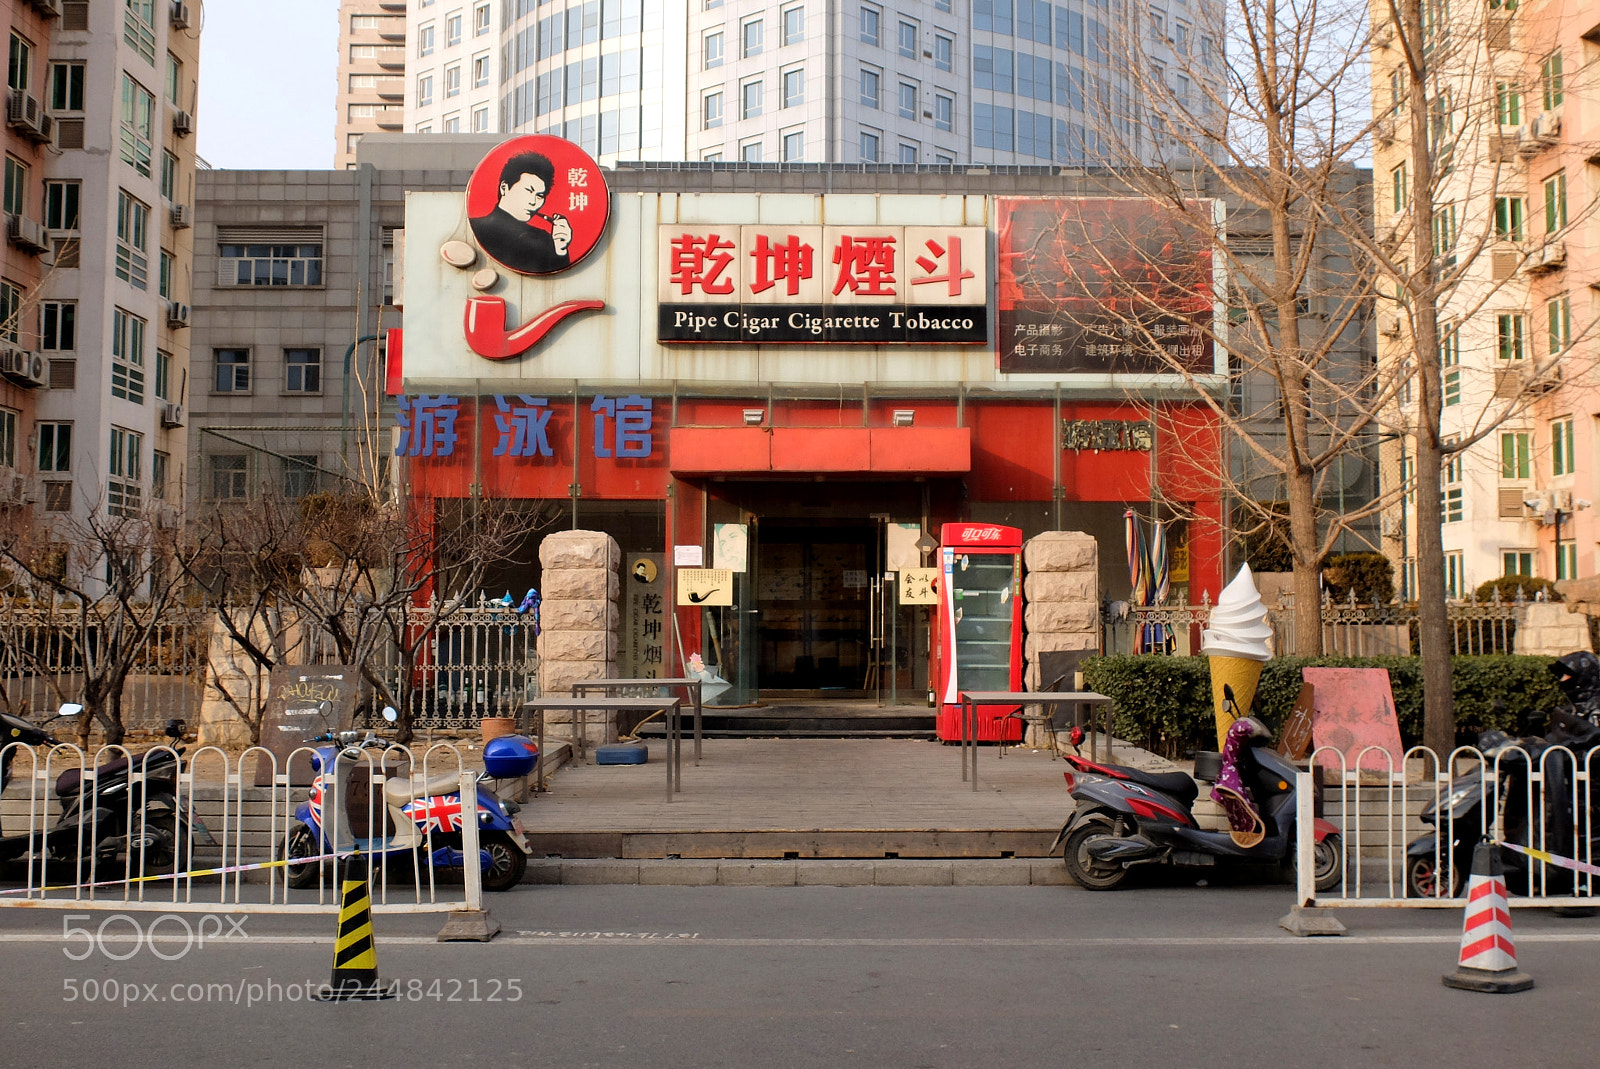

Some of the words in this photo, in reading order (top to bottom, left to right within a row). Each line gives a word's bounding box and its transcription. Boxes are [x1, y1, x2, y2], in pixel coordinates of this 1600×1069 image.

[567, 167, 589, 212] 乾坤
[670, 234, 975, 297] 乾坤煙斗
[674, 312, 717, 332] Pipe
[723, 312, 780, 333] Cigar
[788, 312, 880, 333] Cigarette
[889, 312, 974, 330] Tobacco
[1014, 323, 1063, 337] 产品摄影
[1014, 343, 1063, 357] 电子商务
[1085, 343, 1134, 357] 建筑环境
[395, 394, 653, 458] 游泳馆
[961, 527, 1003, 541] 可口可乐
